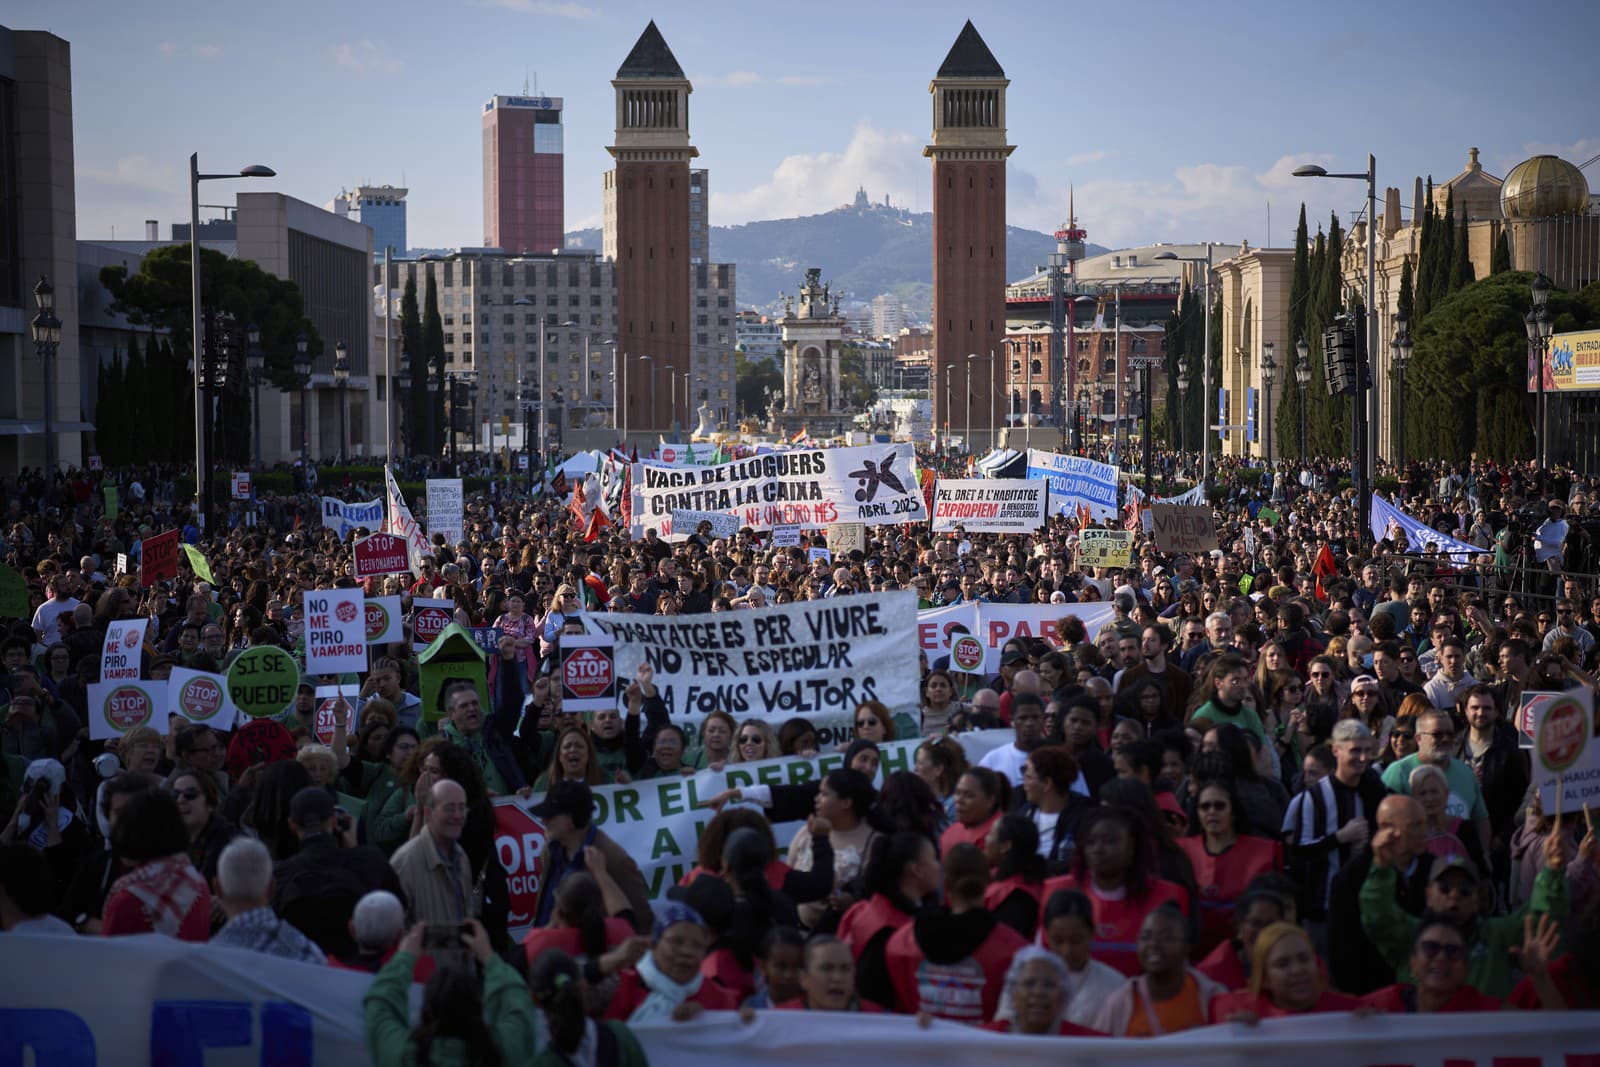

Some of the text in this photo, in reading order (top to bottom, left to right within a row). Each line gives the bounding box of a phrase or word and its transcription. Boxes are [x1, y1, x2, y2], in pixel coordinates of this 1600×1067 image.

[507, 97, 539, 107] Allianz
[701, 467, 725, 485] DE
[730, 451, 826, 481] LLOGUERS
[1093, 464, 1114, 481] AMB
[651, 481, 823, 516] CONTRA LA CAIXA
[937, 489, 1039, 501] PEL DRET A L'HABITATGE
[326, 502, 341, 517] LA
[764, 504, 782, 526] UN
[814, 499, 839, 523] MÉS
[892, 496, 920, 515] 2025
[936, 502, 999, 518] EXPROPIEM
[1084, 531, 1109, 540] ESTA
[145, 538, 175, 564] STOP
[367, 537, 395, 551] STOP
[309, 599, 328, 613] NO
[310, 615, 329, 628] ME
[418, 615, 450, 630] STOP
[721, 620, 745, 648] ES
[754, 614, 795, 646] PER
[805, 603, 887, 641] VIURE,
[109, 627, 123, 640] NO
[310, 630, 343, 645] PIRO
[106, 641, 120, 653] ME
[311, 643, 362, 658] VAMPIRO
[958, 644, 979, 655] STOP
[104, 655, 127, 667] PIRO
[236, 654, 286, 675] SI SE
[645, 642, 852, 676] NO PER ESPECULAR
[104, 668, 138, 679] VAMPIRO
[567, 660, 609, 677] STOP
[187, 685, 217, 701] STOP
[232, 685, 292, 704] PUEDE
[685, 682, 748, 714] FONS
[111, 696, 145, 711] STOP
[592, 788, 643, 826] OR
[657, 779, 704, 817] EL
[495, 832, 545, 876] OP
